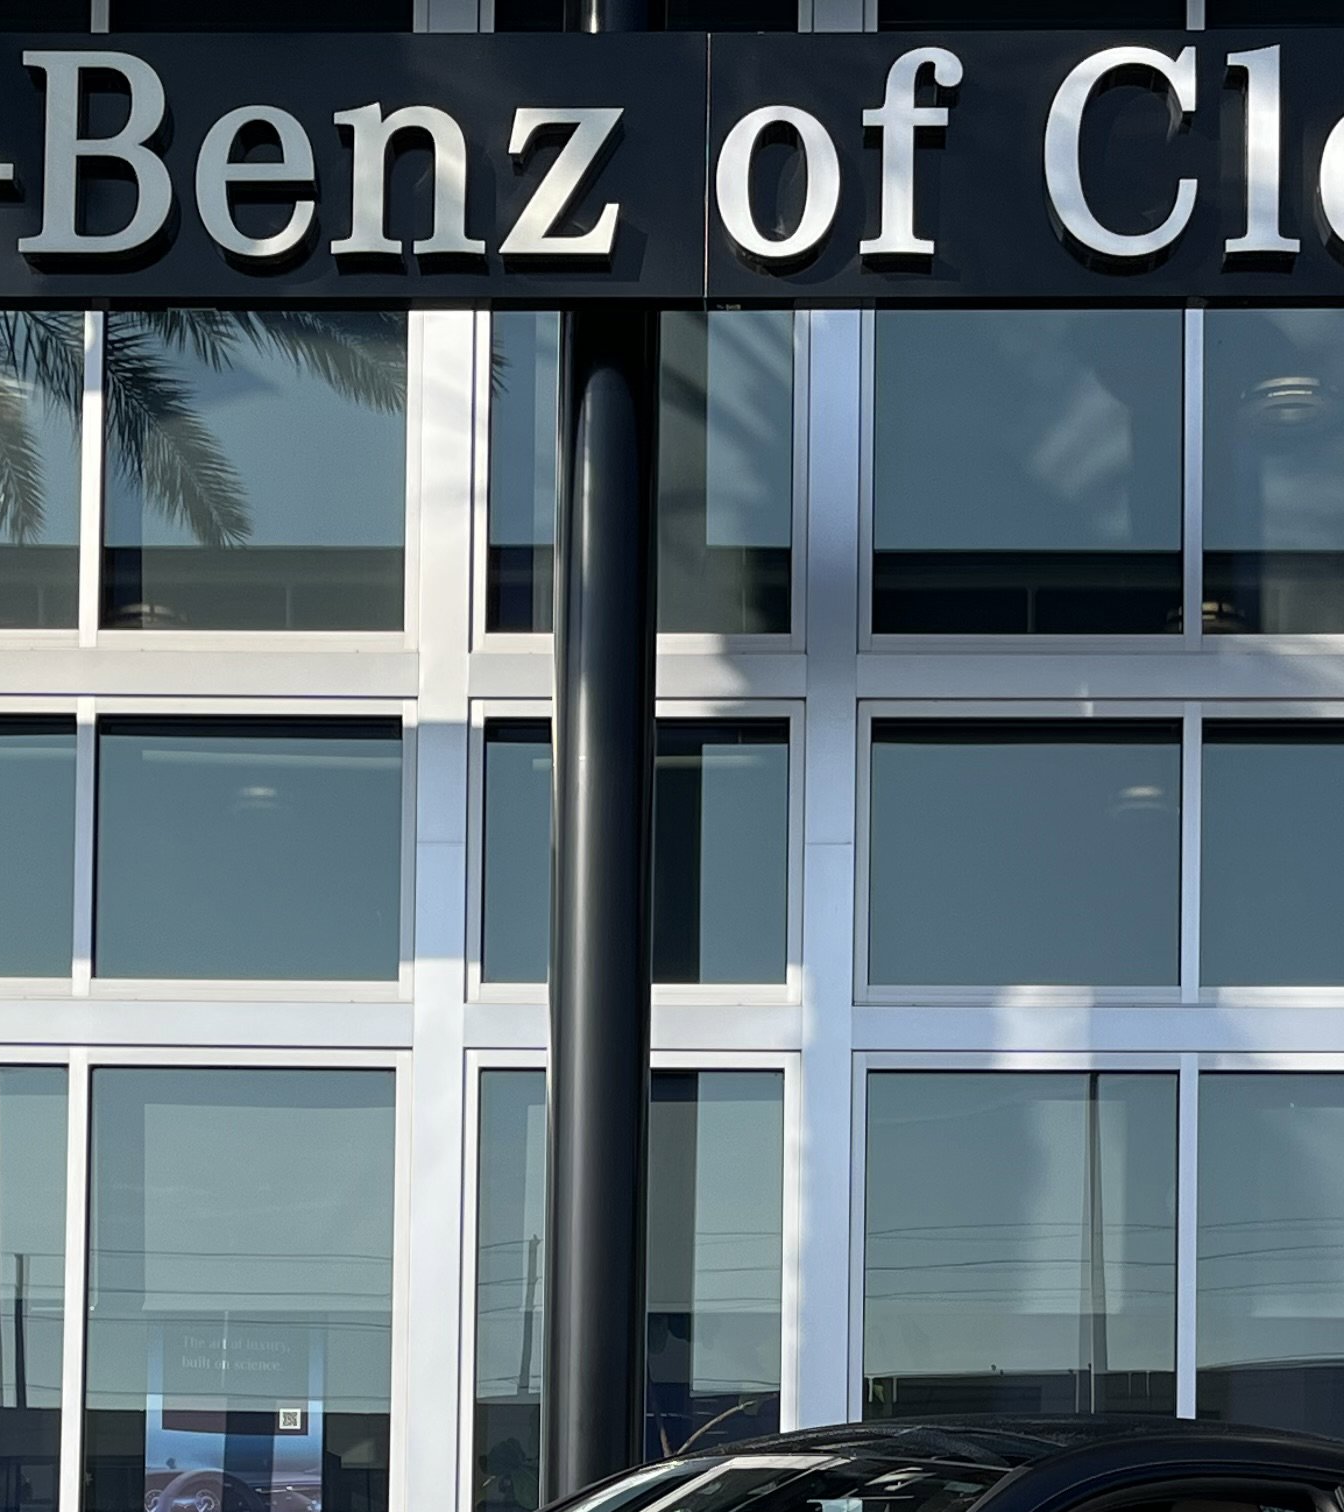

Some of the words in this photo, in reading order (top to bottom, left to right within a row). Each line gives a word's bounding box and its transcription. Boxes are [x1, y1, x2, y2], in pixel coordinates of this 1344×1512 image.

[714, 46, 964, 260] of
[183, 1335, 206, 1349] The
[182, 1354, 210, 1369] built
[214, 1359, 231, 1371] on
